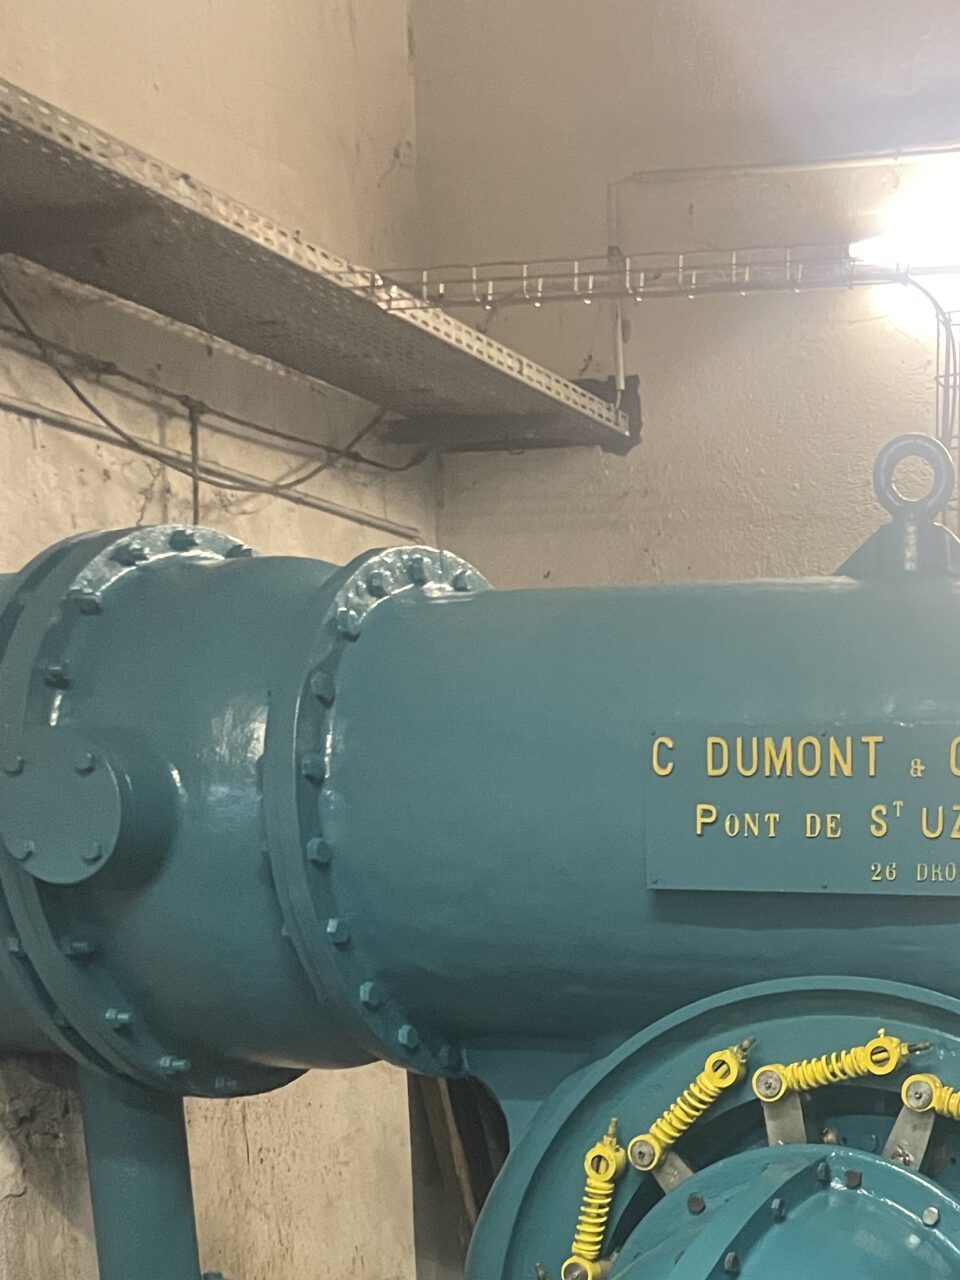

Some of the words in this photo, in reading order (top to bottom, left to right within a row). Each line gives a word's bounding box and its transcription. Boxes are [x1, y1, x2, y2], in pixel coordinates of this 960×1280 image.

[651, 735, 675, 777] C
[705, 734, 885, 779] DUMONT
[909, 758, 926, 778] &
[695, 803, 780, 838] PONT
[804, 812, 842, 838] DE
[870, 862, 897, 882] 26
